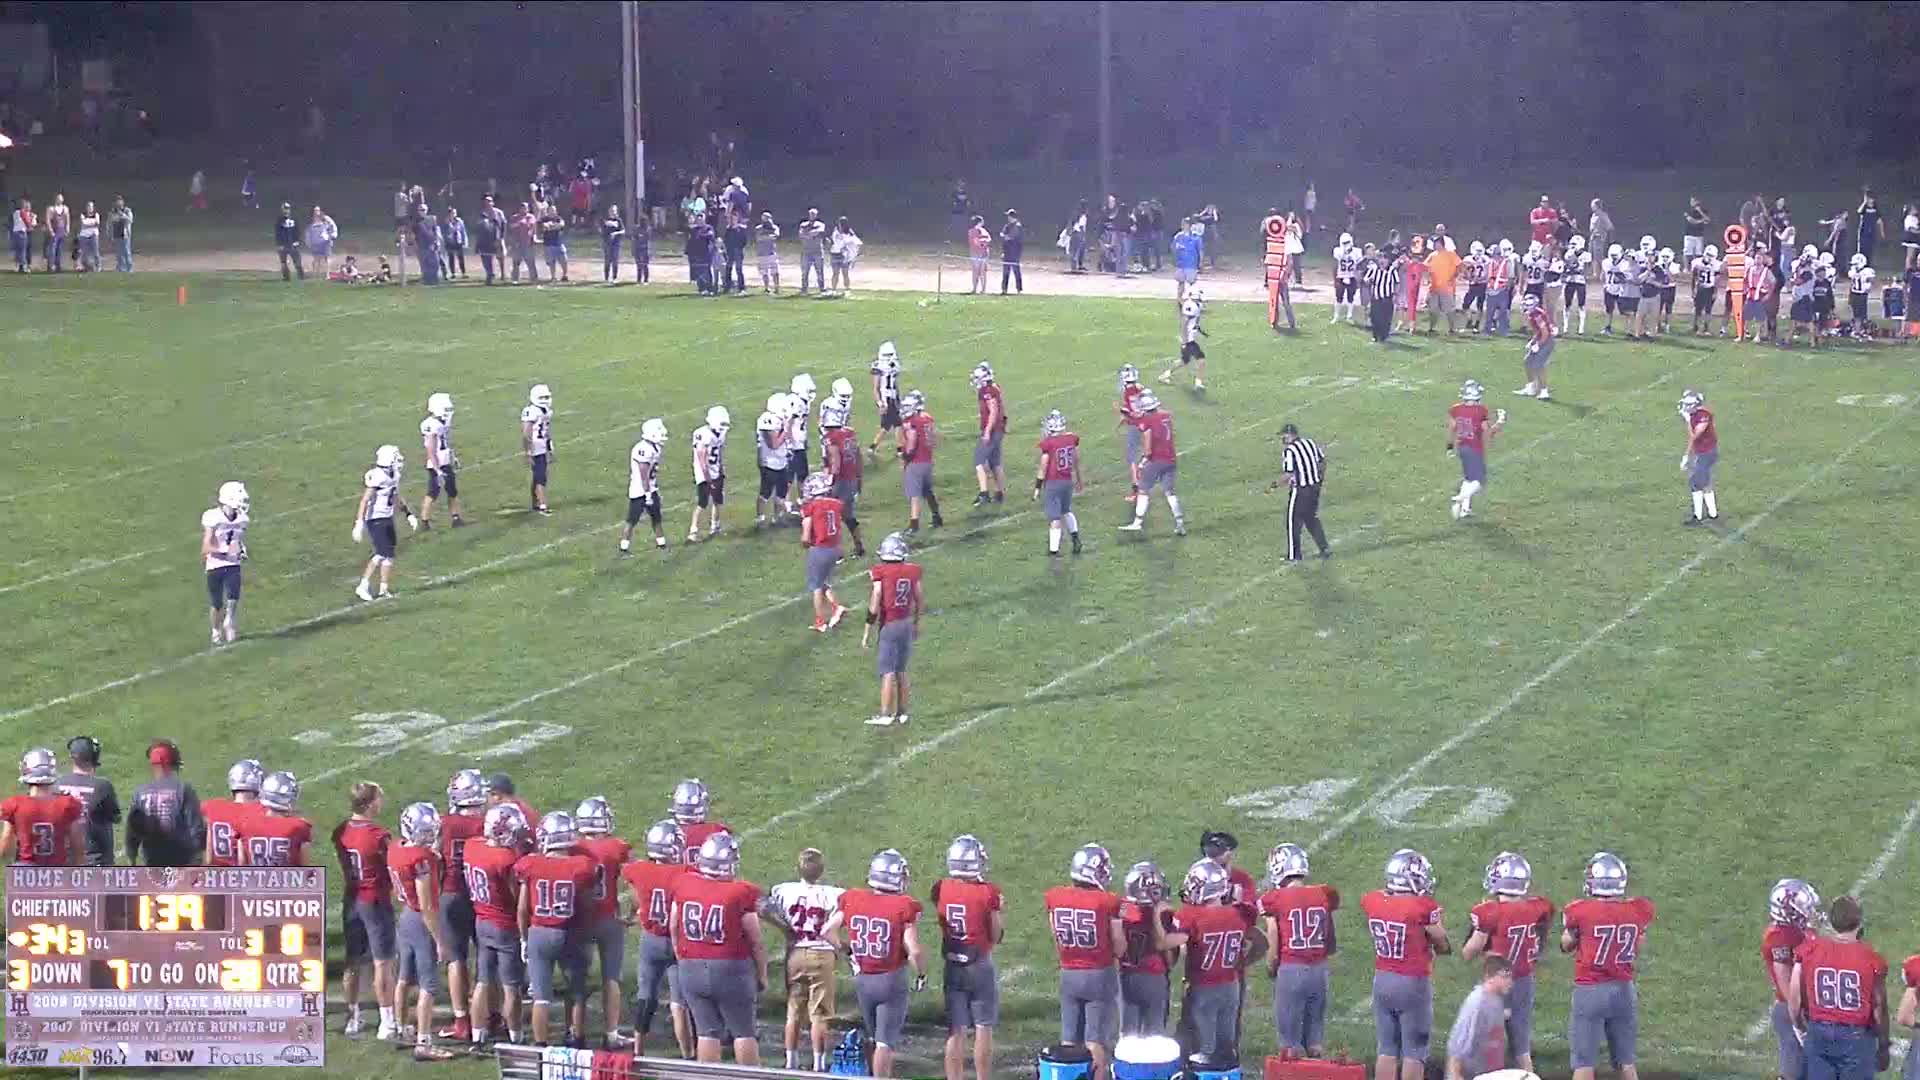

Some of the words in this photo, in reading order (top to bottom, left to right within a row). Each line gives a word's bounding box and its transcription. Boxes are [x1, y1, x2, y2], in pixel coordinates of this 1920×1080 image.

[895, 578, 912, 607] 2
[32, 822, 55, 856] 3
[682, 901, 725, 944] 64
[851, 915, 890, 959] 33
[946, 904, 967, 940] 5
[1054, 907, 1098, 949] 55
[1288, 906, 1327, 950] 12
[1201, 930, 1244, 971] 76
[1594, 923, 1639, 966] 72
[1815, 967, 1861, 1011] 66
